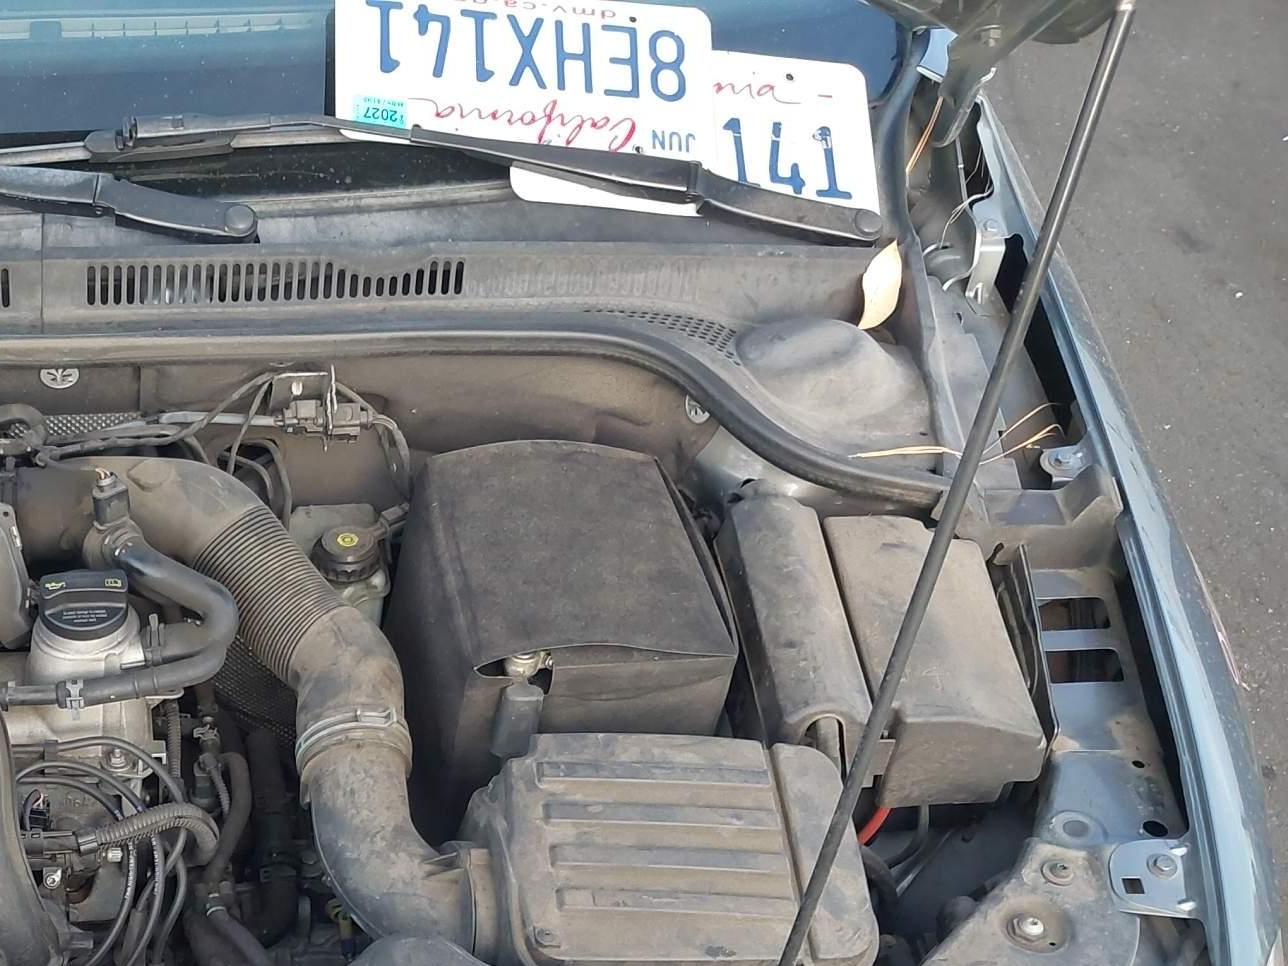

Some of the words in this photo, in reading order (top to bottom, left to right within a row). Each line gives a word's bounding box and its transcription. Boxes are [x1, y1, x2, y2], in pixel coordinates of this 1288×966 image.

[365, 0, 687, 102] 8EHX141
[363, 106, 398, 123] 2027
[408, 97, 637, 153] California
[650, 129, 697, 153] JUN
